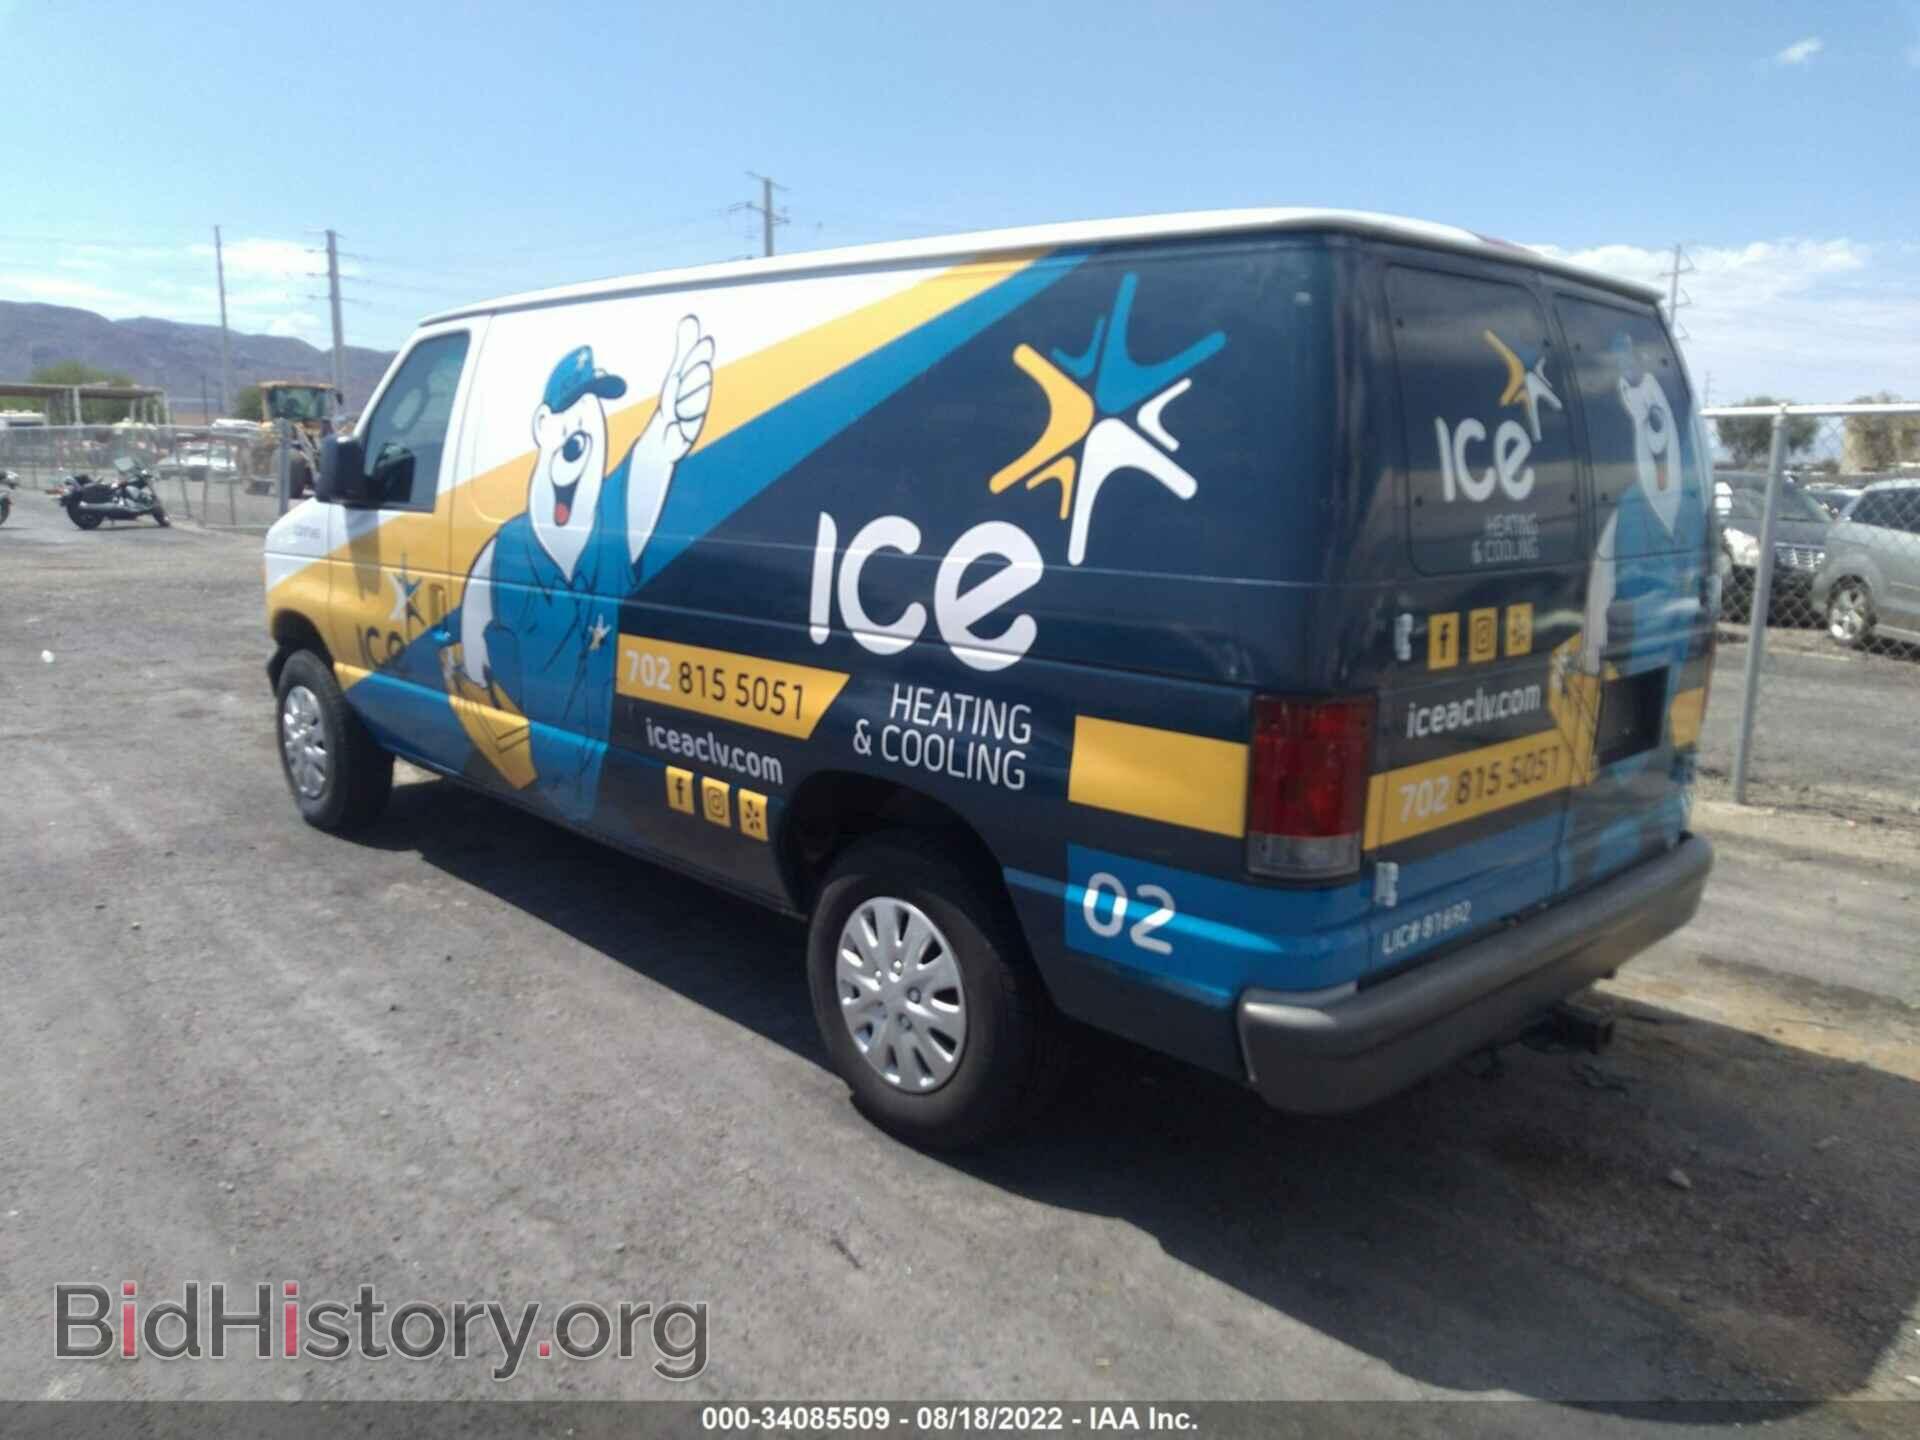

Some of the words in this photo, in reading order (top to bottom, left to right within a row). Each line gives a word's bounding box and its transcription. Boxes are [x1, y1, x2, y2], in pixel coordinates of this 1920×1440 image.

[625, 649, 672, 691] 702
[678, 661, 726, 702] 815
[735, 672, 804, 720] 5051
[890, 683, 1031, 744] HEATING
[1406, 685, 1541, 739] iceaclv.com
[645, 718, 783, 784] iceaclv.com
[853, 718, 873, 756] &
[881, 725, 1026, 791] COOLING
[1401, 775, 1449, 824] 702
[1457, 760, 1503, 804] 815
[1507, 745, 1560, 790] 5051
[1083, 872, 1176, 955] 02
